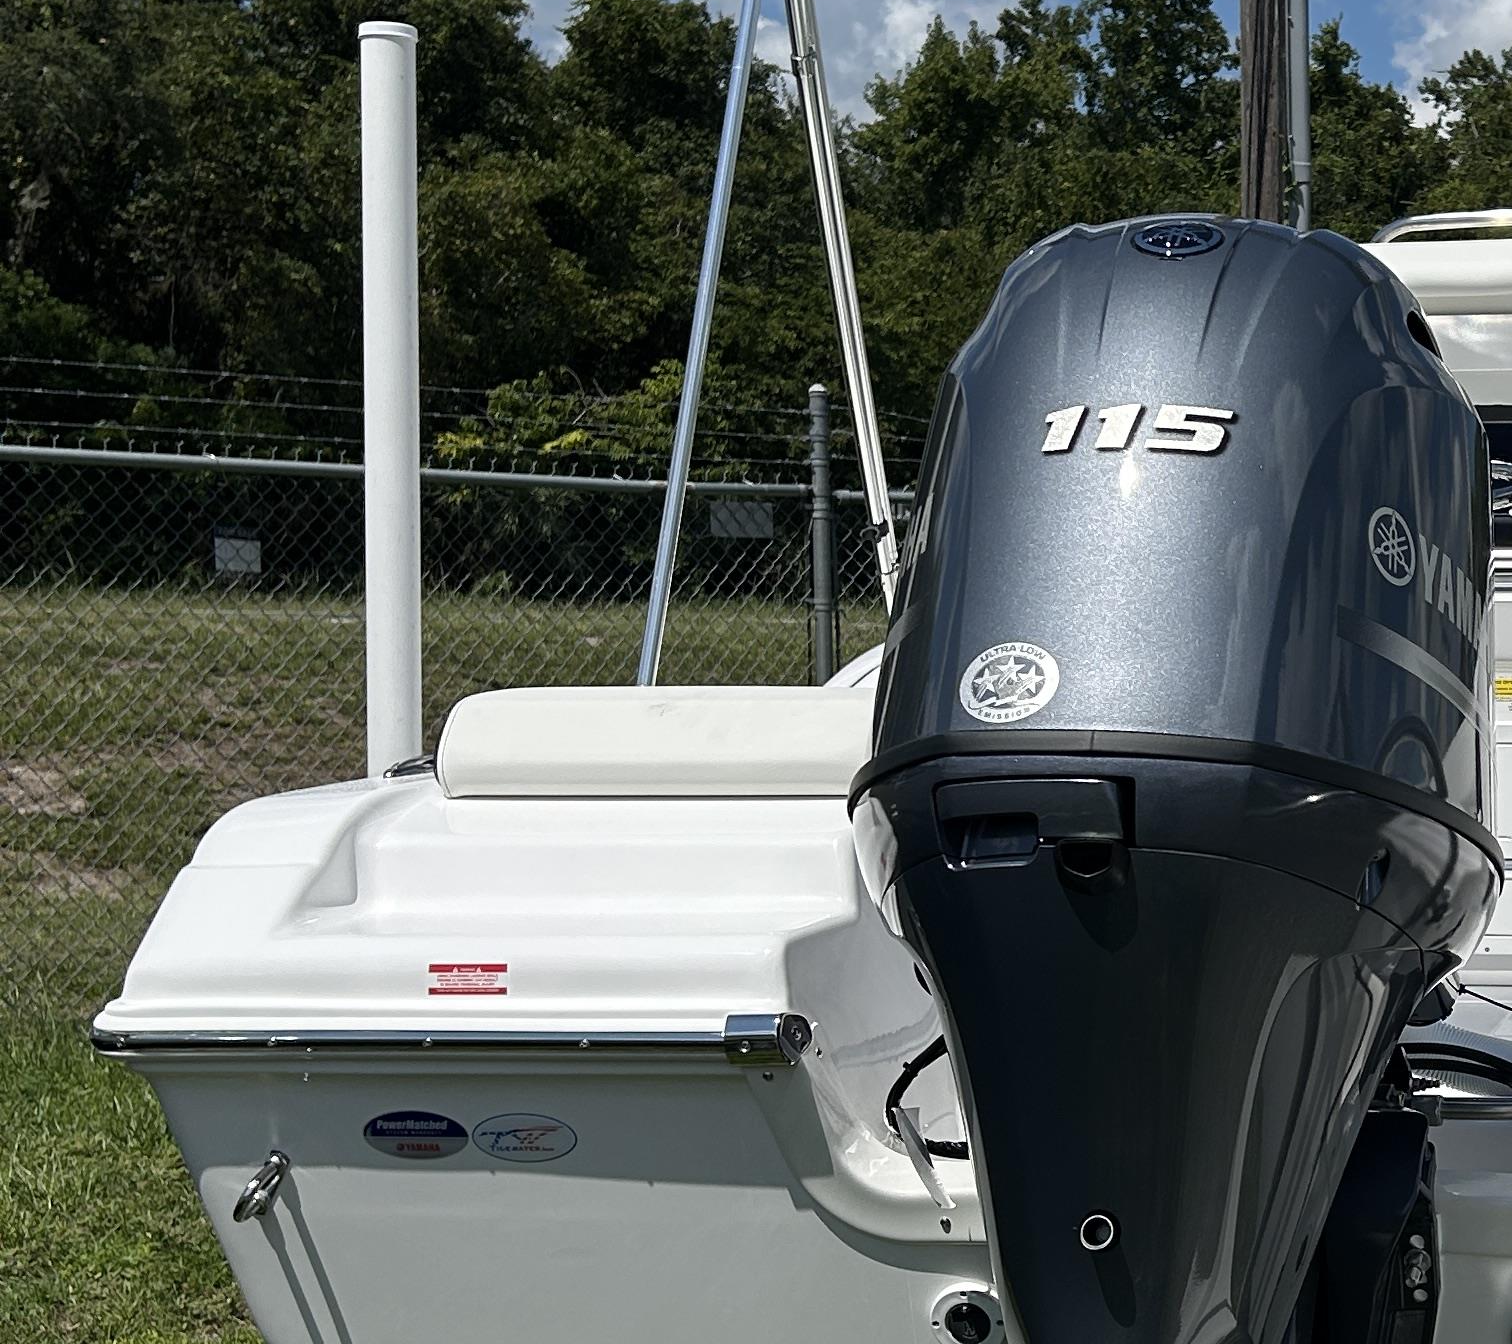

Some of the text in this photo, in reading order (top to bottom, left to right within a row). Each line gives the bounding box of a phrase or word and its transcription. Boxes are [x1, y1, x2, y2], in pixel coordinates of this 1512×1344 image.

[1041, 403, 1237, 456] 115
[980, 645, 1046, 662] ULTRA LOW
[376, 1120, 448, 1130] PowerMatched
[406, 1143, 440, 1152] YAMAHA
